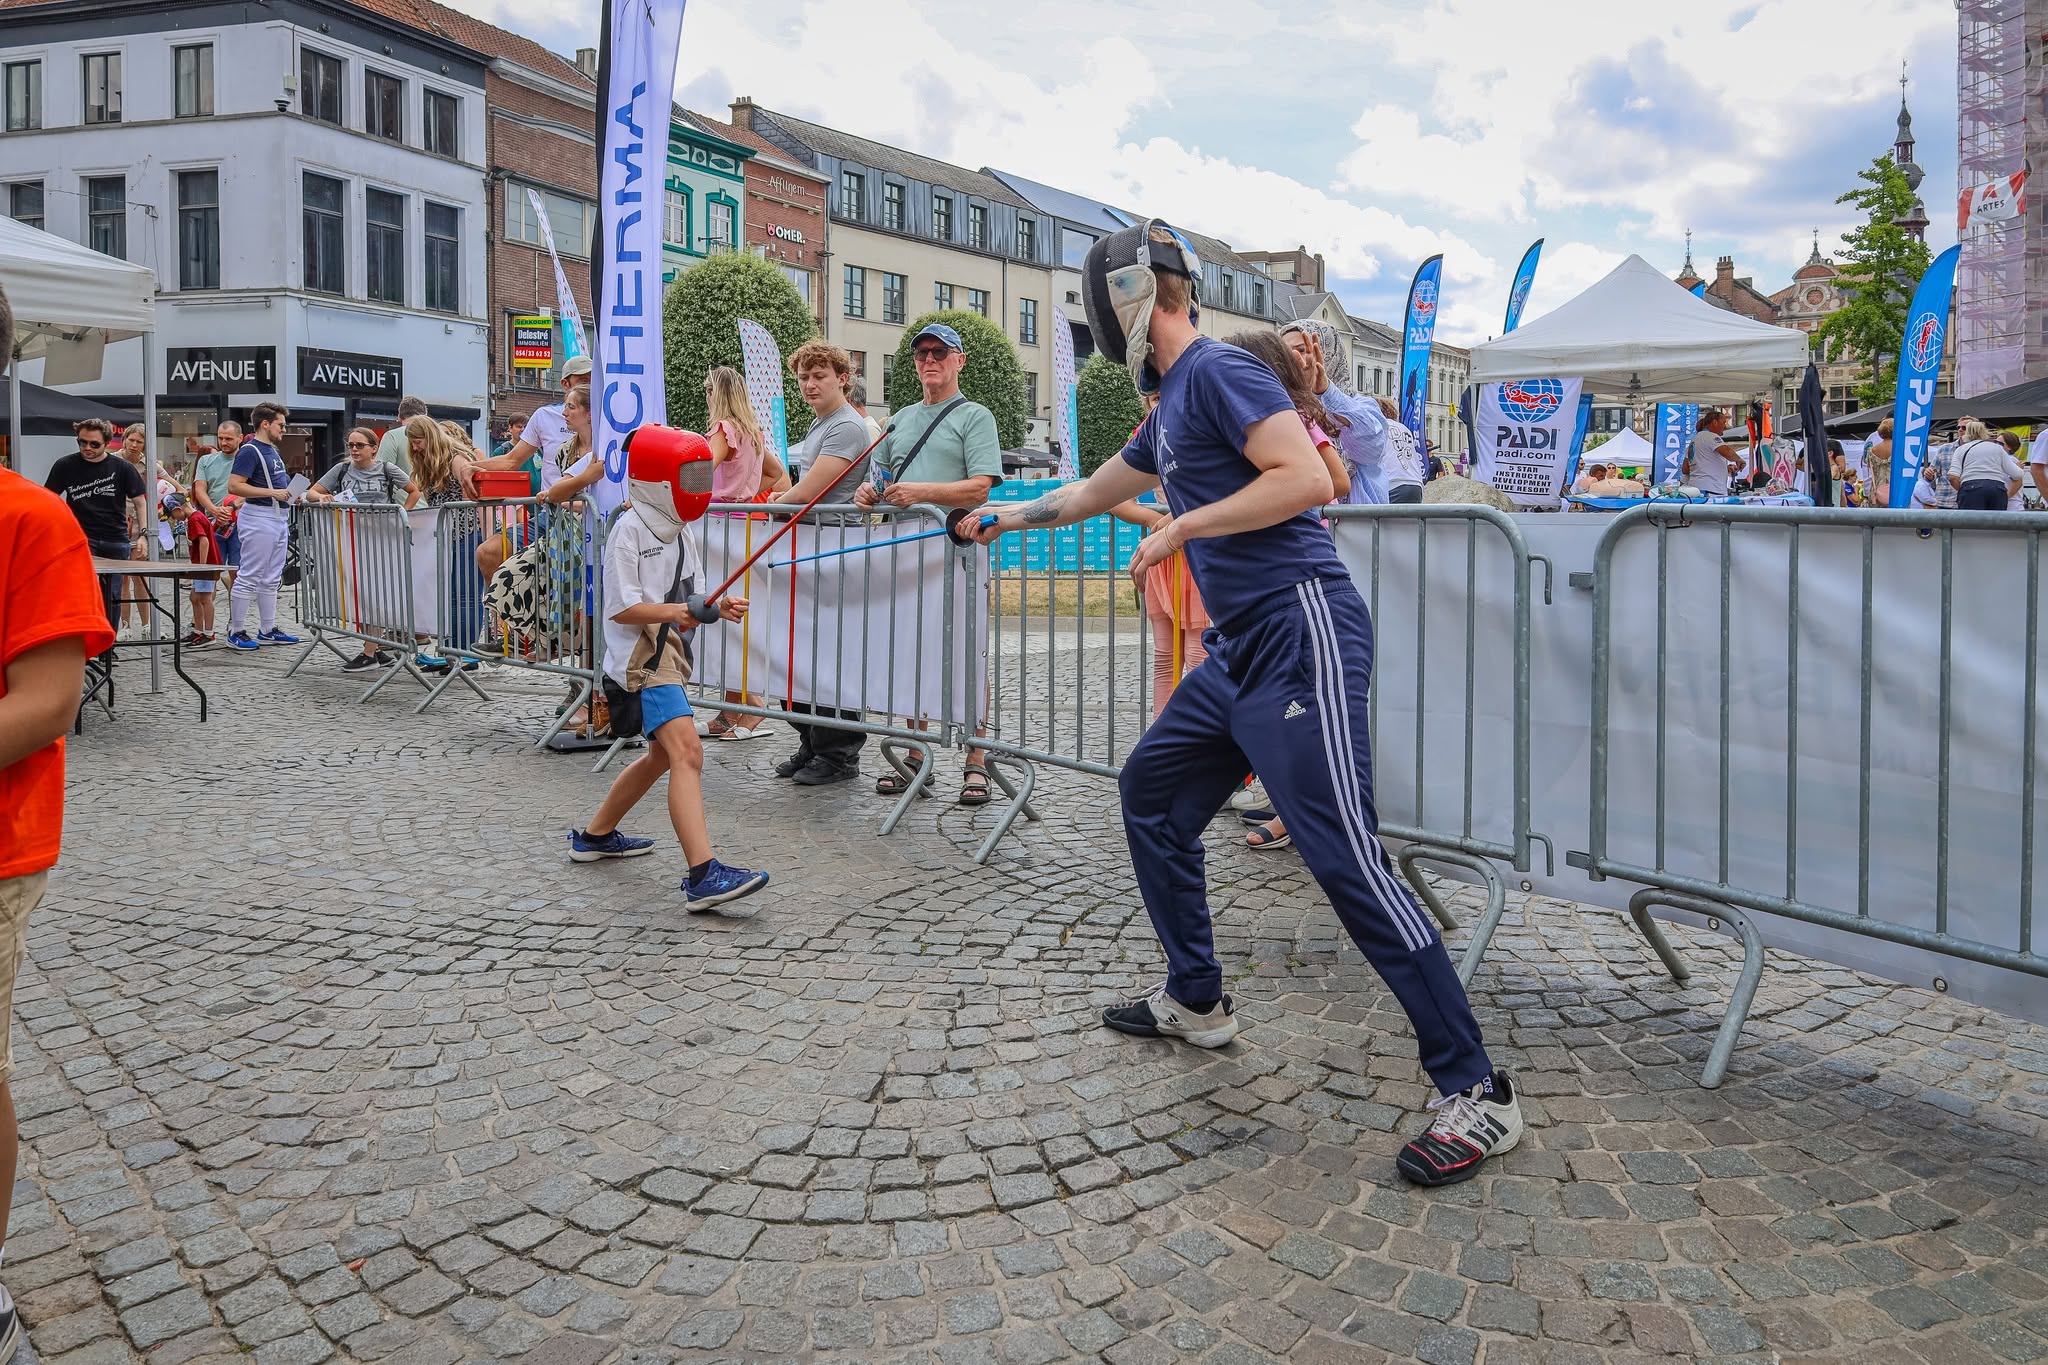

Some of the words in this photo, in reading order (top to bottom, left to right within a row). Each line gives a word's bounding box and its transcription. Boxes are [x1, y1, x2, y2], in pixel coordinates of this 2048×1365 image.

[768, 176, 805, 196] Affligem
[1977, 200, 2005, 214] ARTES
[603, 80, 646, 483] SCHERMA
[518, 330, 549, 340] Delestré
[1410, 327, 1433, 344] PADI
[170, 360, 255, 381] AVENUE
[263, 359, 271, 380] 1
[312, 364, 386, 388] AVENUE
[391, 372, 400, 390] 1
[1901, 379, 1933, 477] PADI
[1496, 426, 1558, 450] PADI
[1495, 450, 1556, 461] padi.com
[1492, 477, 1552, 487] DEVELOPMENT
[1495, 471, 1550, 480] INSTRUCTOR
[1284, 707, 1307, 719] adidas
